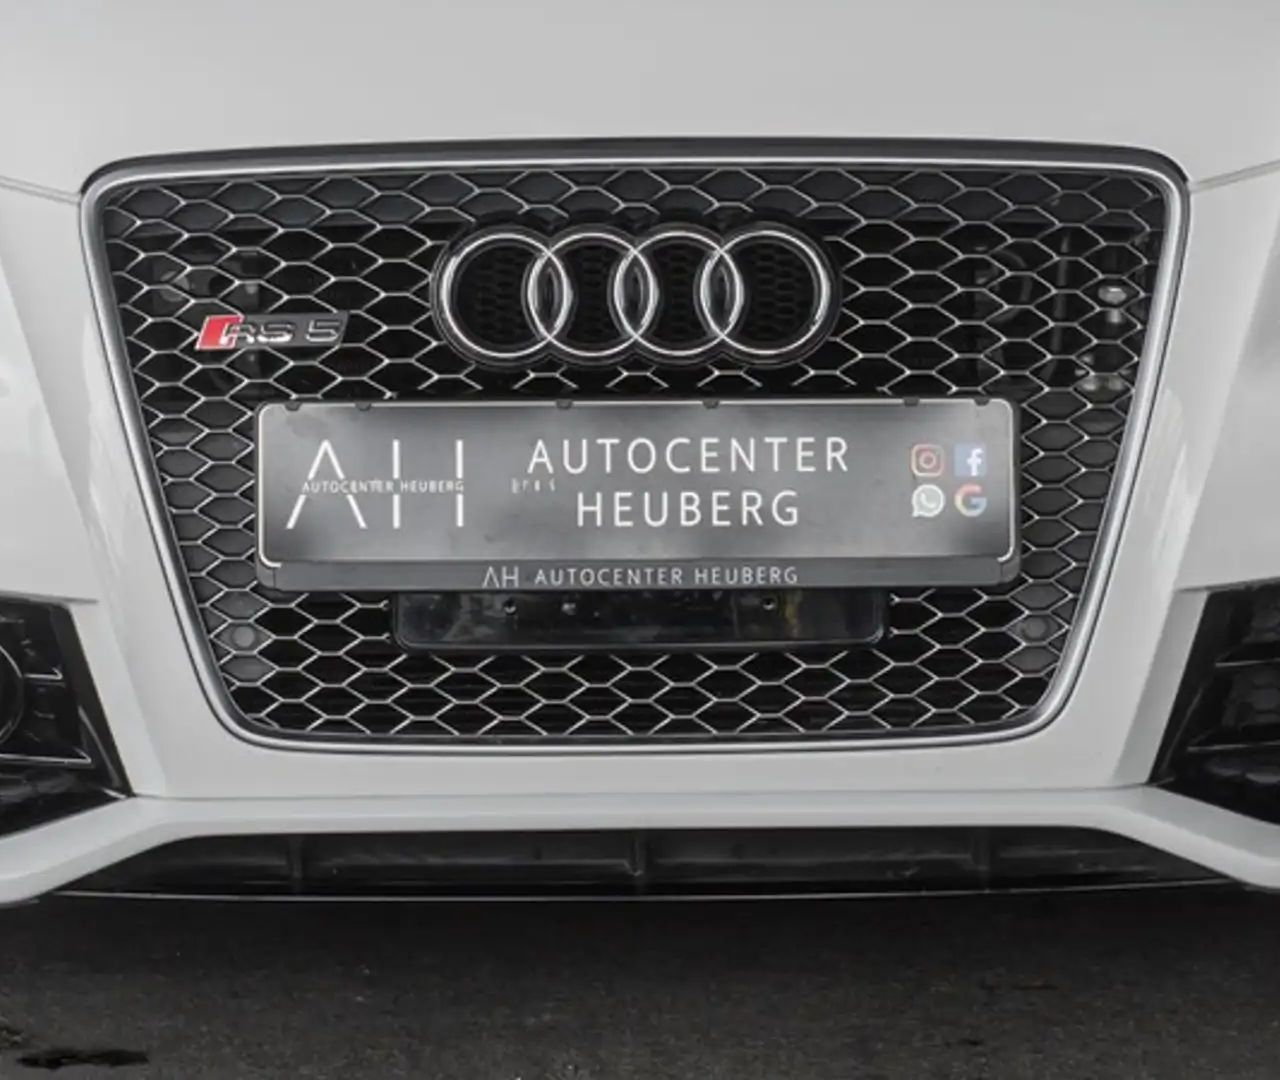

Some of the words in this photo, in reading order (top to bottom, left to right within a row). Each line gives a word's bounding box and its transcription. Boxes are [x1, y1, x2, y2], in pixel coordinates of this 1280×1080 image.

[216, 320, 297, 346] RS
[305, 318, 343, 344] 5
[524, 437, 850, 475] AUTOCENTER
[285, 438, 465, 529] AH
[301, 479, 395, 494] AUTOCENTER
[400, 479, 465, 494] HEUBERG
[576, 491, 800, 528] HEUBERG
[481, 566, 520, 589] AH
[533, 568, 684, 587] AUTOCENTER
[694, 567, 799, 586] HEUBERG
